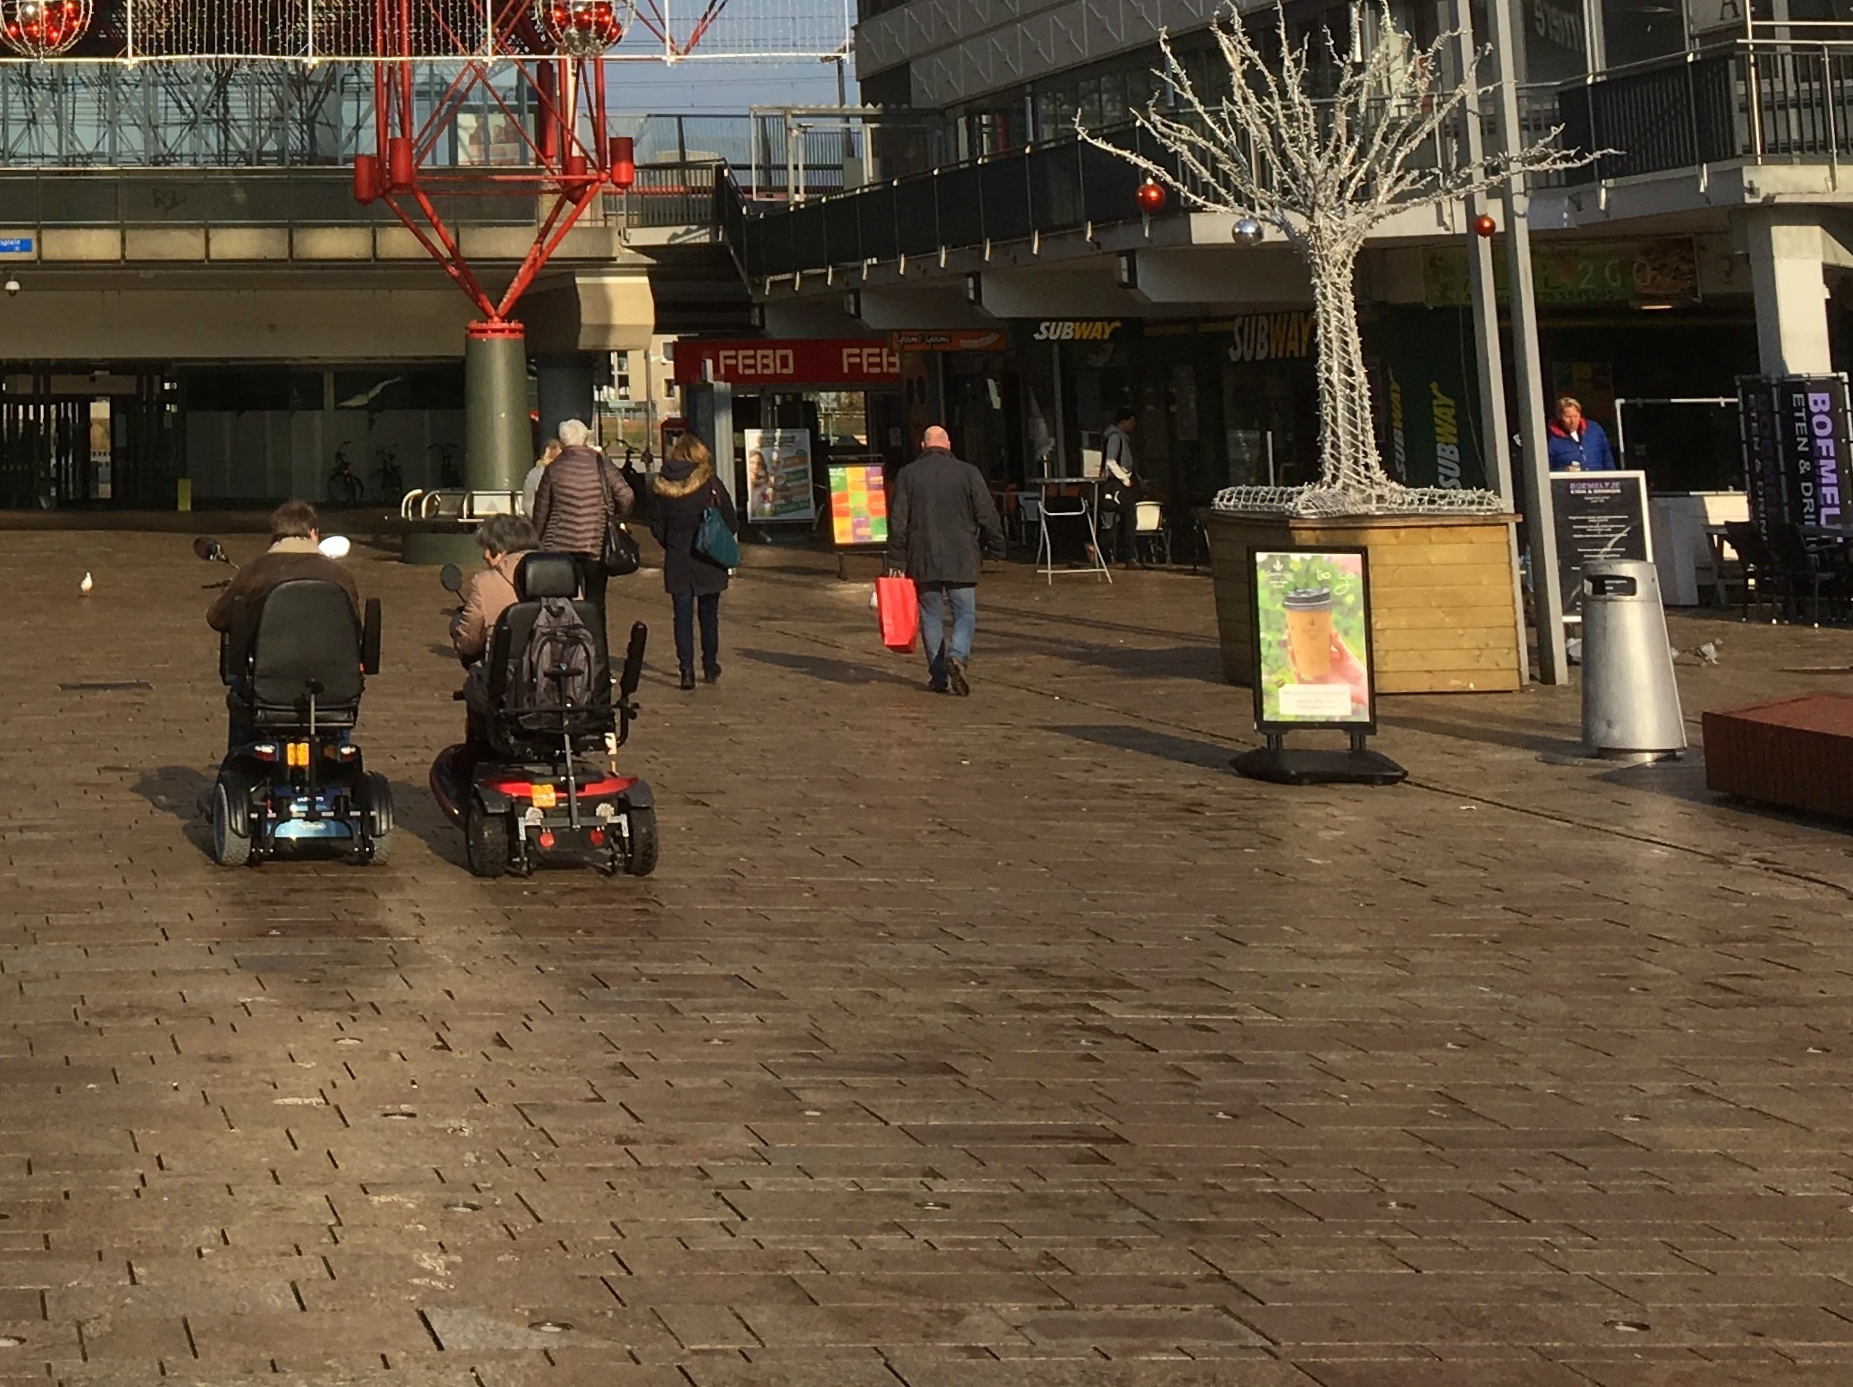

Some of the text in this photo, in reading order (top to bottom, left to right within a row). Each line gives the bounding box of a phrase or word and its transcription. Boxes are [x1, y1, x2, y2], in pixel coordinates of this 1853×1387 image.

[1033, 320, 1122, 341] SUBWAY
[1228, 312, 1316, 362] SUBWAY
[719, 349, 794, 374] FEBO
[1430, 381, 1462, 490] SUBWAY
[1792, 393, 1810, 452] ETEN
[1798, 458, 1812, 475] &
[1316, 569, 1332, 581] to
[1333, 570, 1357, 596] go
